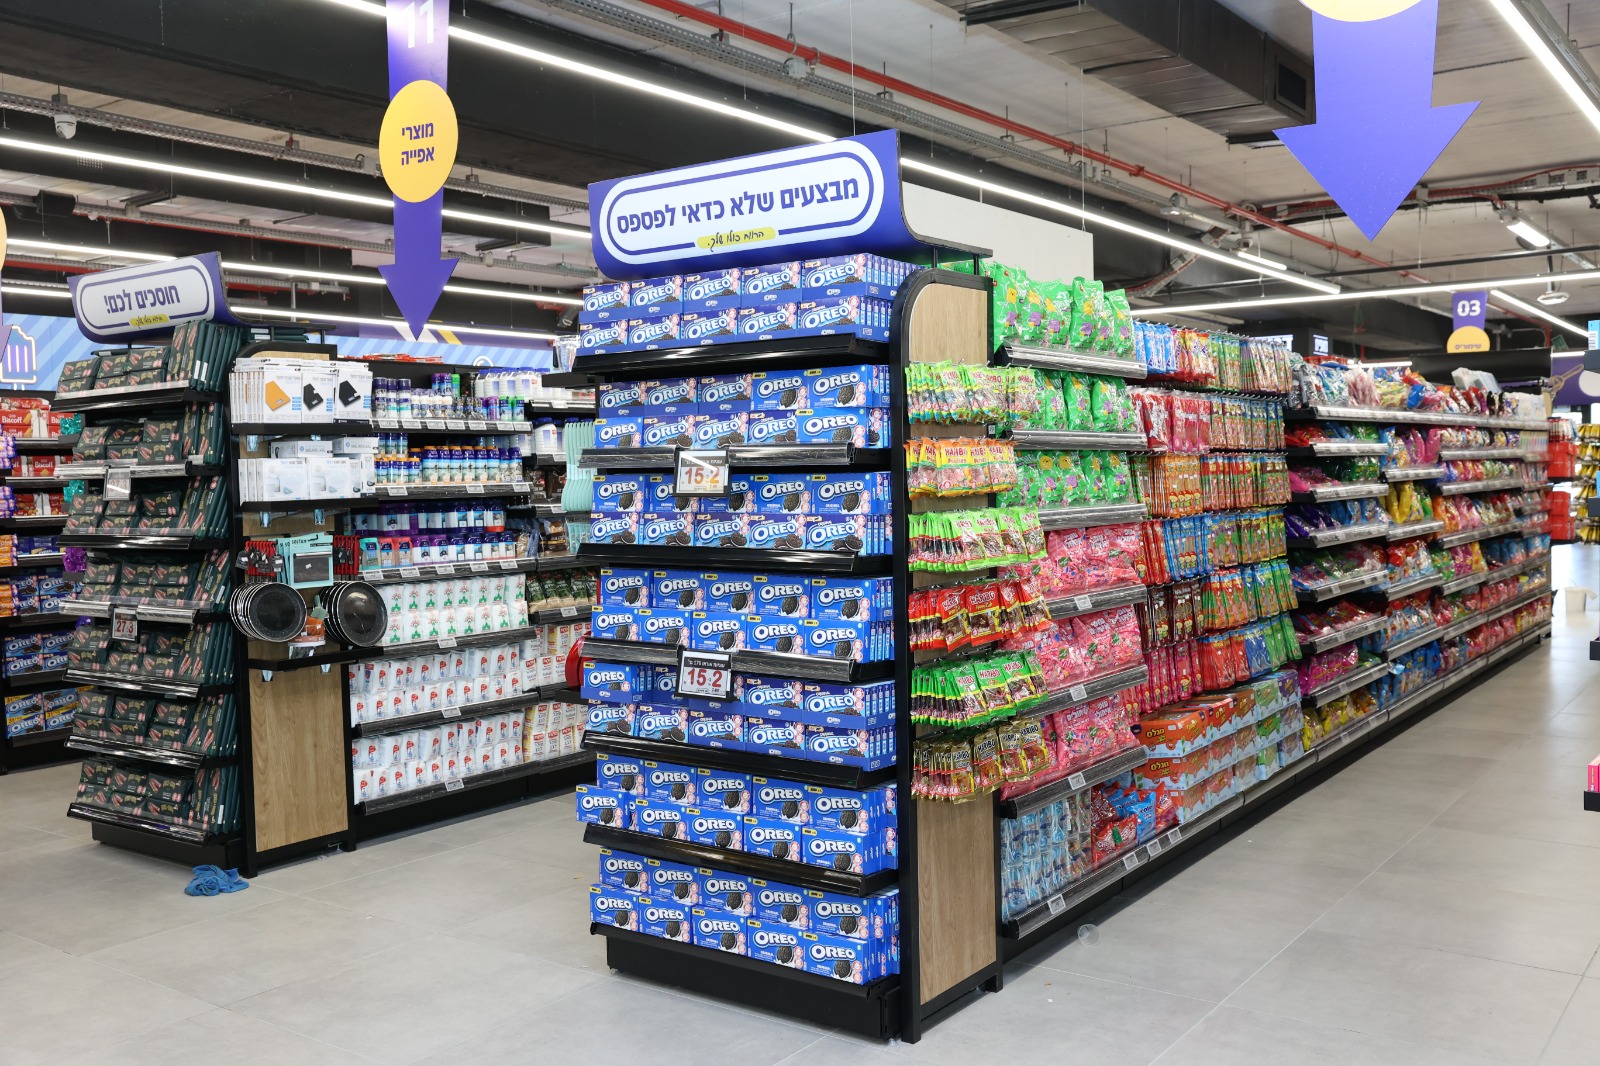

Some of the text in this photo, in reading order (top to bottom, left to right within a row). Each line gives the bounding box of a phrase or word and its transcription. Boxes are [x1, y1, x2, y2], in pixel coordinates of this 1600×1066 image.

[402, 123, 434, 140] מוצרי
[402, 147, 434, 165] אפייה
[617, 178, 859, 234] מבצעים שלא כדאי לפספס
[726, 230, 740, 242] כולו
[749, 272, 790, 294] OREO
[810, 264, 854, 286] OREO
[636, 286, 673, 306] OREO
[690, 278, 730, 300] OREO
[104, 286, 180, 314] חוסכים לכם!
[586, 292, 622, 311] OREO
[1458, 300, 1481, 316] 03
[745, 313, 786, 334] OREO
[805, 306, 848, 328] OREO
[633, 324, 670, 343] OREO
[688, 317, 728, 338] OREO
[583, 328, 618, 348] OREO
[760, 378, 801, 396] OREO
[814, 373, 859, 393] OREO
[603, 390, 638, 407] OREO
[650, 387, 686, 405] OREO
[706, 383, 744, 402] OREO
[600, 424, 636, 440] OREO
[648, 424, 686, 442] OREO
[699, 420, 738, 440] OREO
[753, 420, 796, 439] OREO
[805, 416, 858, 434] OREO
[685, 467, 704, 484] 15
[599, 481, 638, 497] OREO
[762, 481, 805, 499] OREO
[820, 480, 864, 498] OREO
[594, 520, 631, 538] OREO
[647, 520, 684, 538] OREO
[700, 520, 740, 539] OREO
[753, 521, 796, 540] OREO
[810, 522, 856, 542] OREO
[607, 577, 643, 591] OREO
[660, 579, 699, 593] OREO
[712, 582, 751, 596] OREO
[762, 585, 802, 599] OREO
[819, 587, 863, 604] OREO
[970, 591, 995, 604] HARIBO
[597, 614, 632, 628] OREO
[645, 617, 684, 632] OREO
[699, 620, 739, 634] OREO
[753, 625, 797, 640] OREO
[812, 628, 856, 643] OREO
[590, 671, 624, 685] OREO
[688, 668, 706, 686] 15
[712, 670, 722, 687] 2
[751, 687, 793, 705] OREO
[810, 694, 854, 712] OREO
[589, 709, 626, 722] OREO
[643, 716, 679, 729] OREO
[694, 722, 734, 736] OREO
[752, 728, 794, 745] OREO
[1021, 725, 1038, 737] HARIBO
[814, 734, 857, 752] OREO
[977, 739, 996, 752] HARIBO
[602, 764, 639, 778] OREO
[651, 771, 690, 786] OREO
[704, 779, 744, 793] OREO
[761, 786, 802, 801] OREO
[582, 796, 617, 810] OREO
[816, 796, 861, 812] OREO
[642, 809, 679, 823] OREO
[694, 816, 735, 832] OREO
[751, 826, 793, 843] OREO
[810, 840, 856, 857] OREO
[605, 860, 643, 873] OREO
[654, 869, 693, 885] OREO
[705, 879, 747, 894] OREO
[596, 897, 632, 911] OREO
[761, 889, 802, 905] OREO
[645, 909, 684, 924] OREO
[816, 902, 862, 917] OREO
[700, 918, 739, 934] OREO
[754, 931, 796, 947] OREO
[810, 945, 856, 962] OREO
